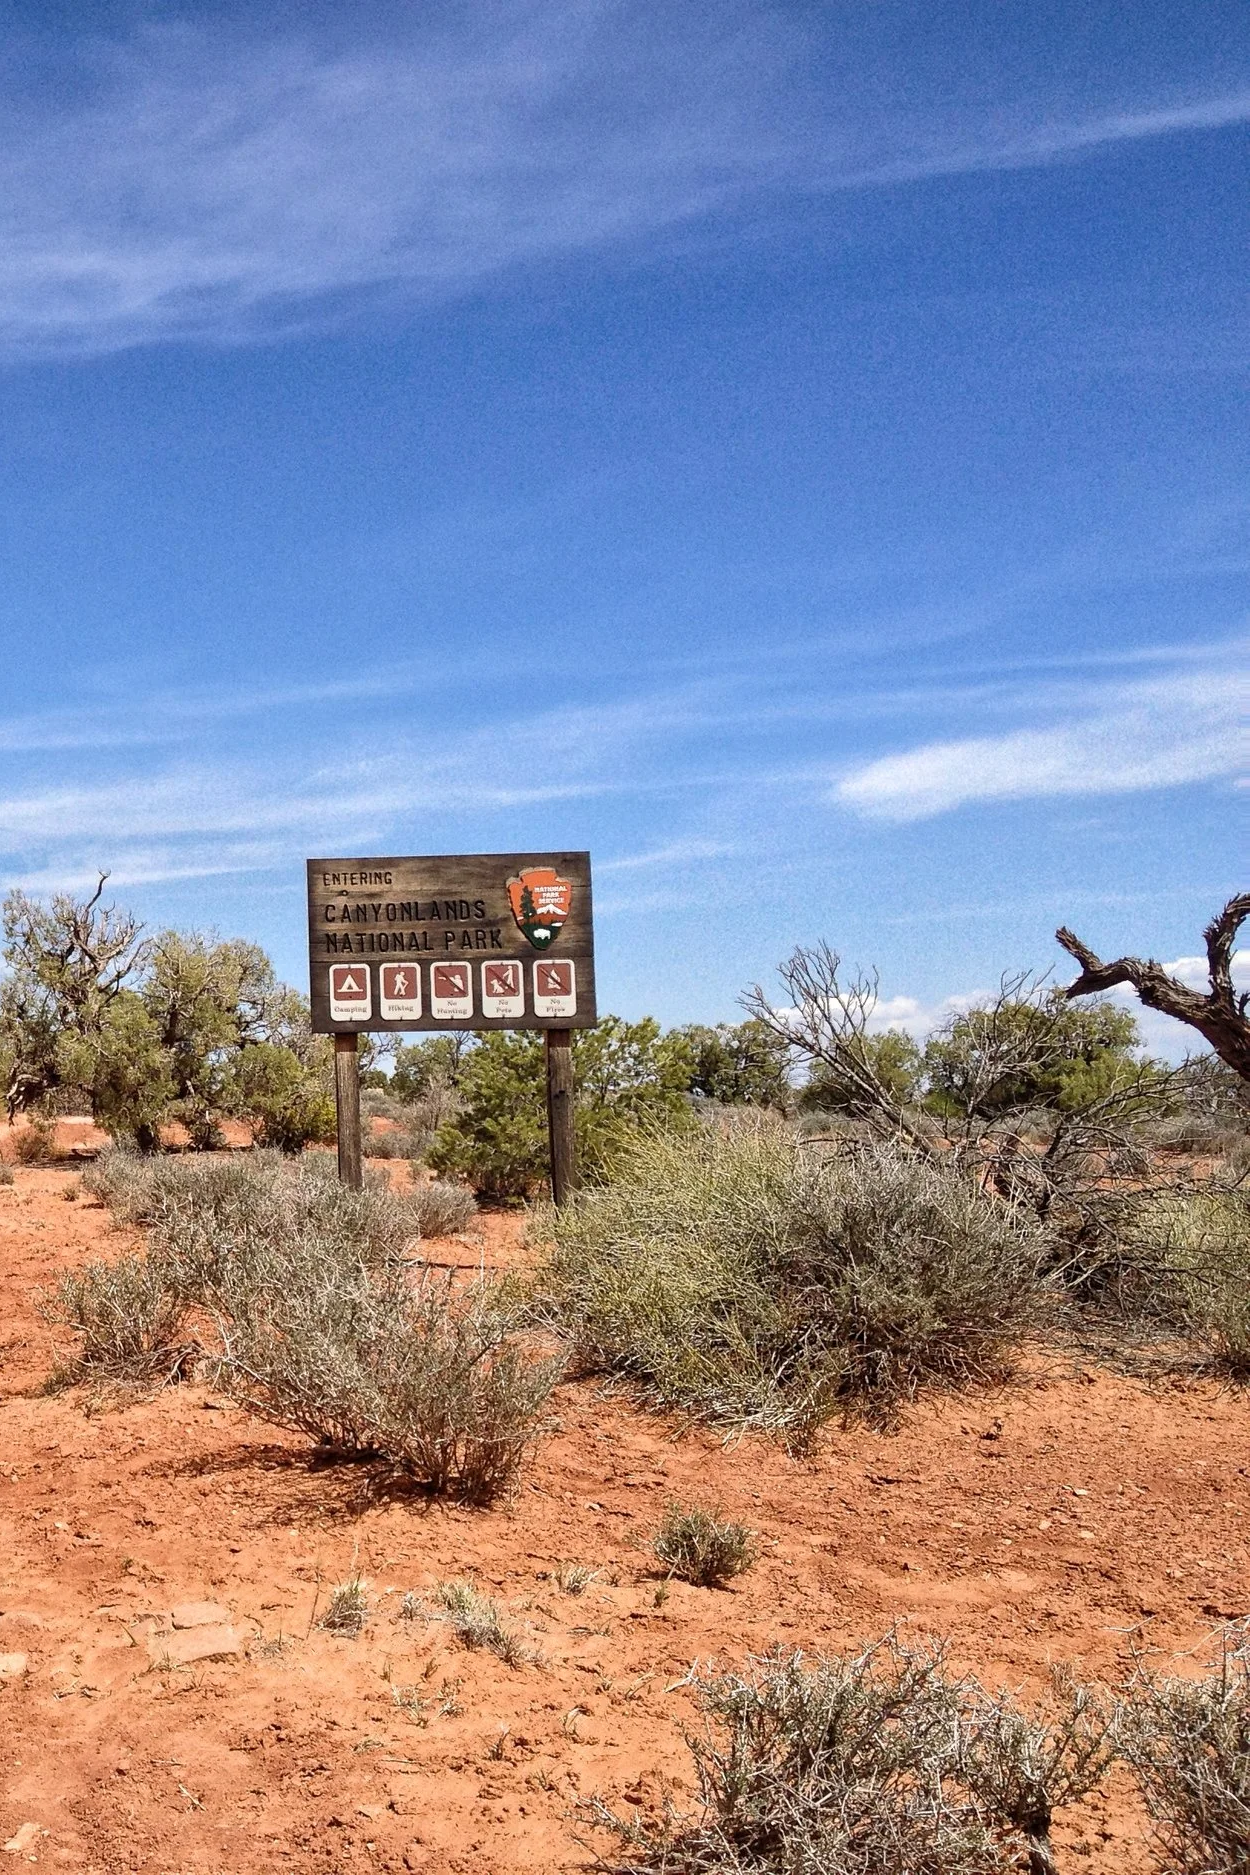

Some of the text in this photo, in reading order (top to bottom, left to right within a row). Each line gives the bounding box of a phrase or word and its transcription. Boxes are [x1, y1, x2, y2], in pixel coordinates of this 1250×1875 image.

[323, 871, 393, 887] ENTERING
[534, 885, 568, 893] NATIONAL
[542, 891, 560, 899] PARK
[324, 899, 486, 924] CANYONLANDS
[325, 928, 503, 953] NATIONAL PARK
[334, 1004, 368, 1014] Camping
[388, 1004, 414, 1013] Hiking
[436, 1007, 468, 1016] Hunting
